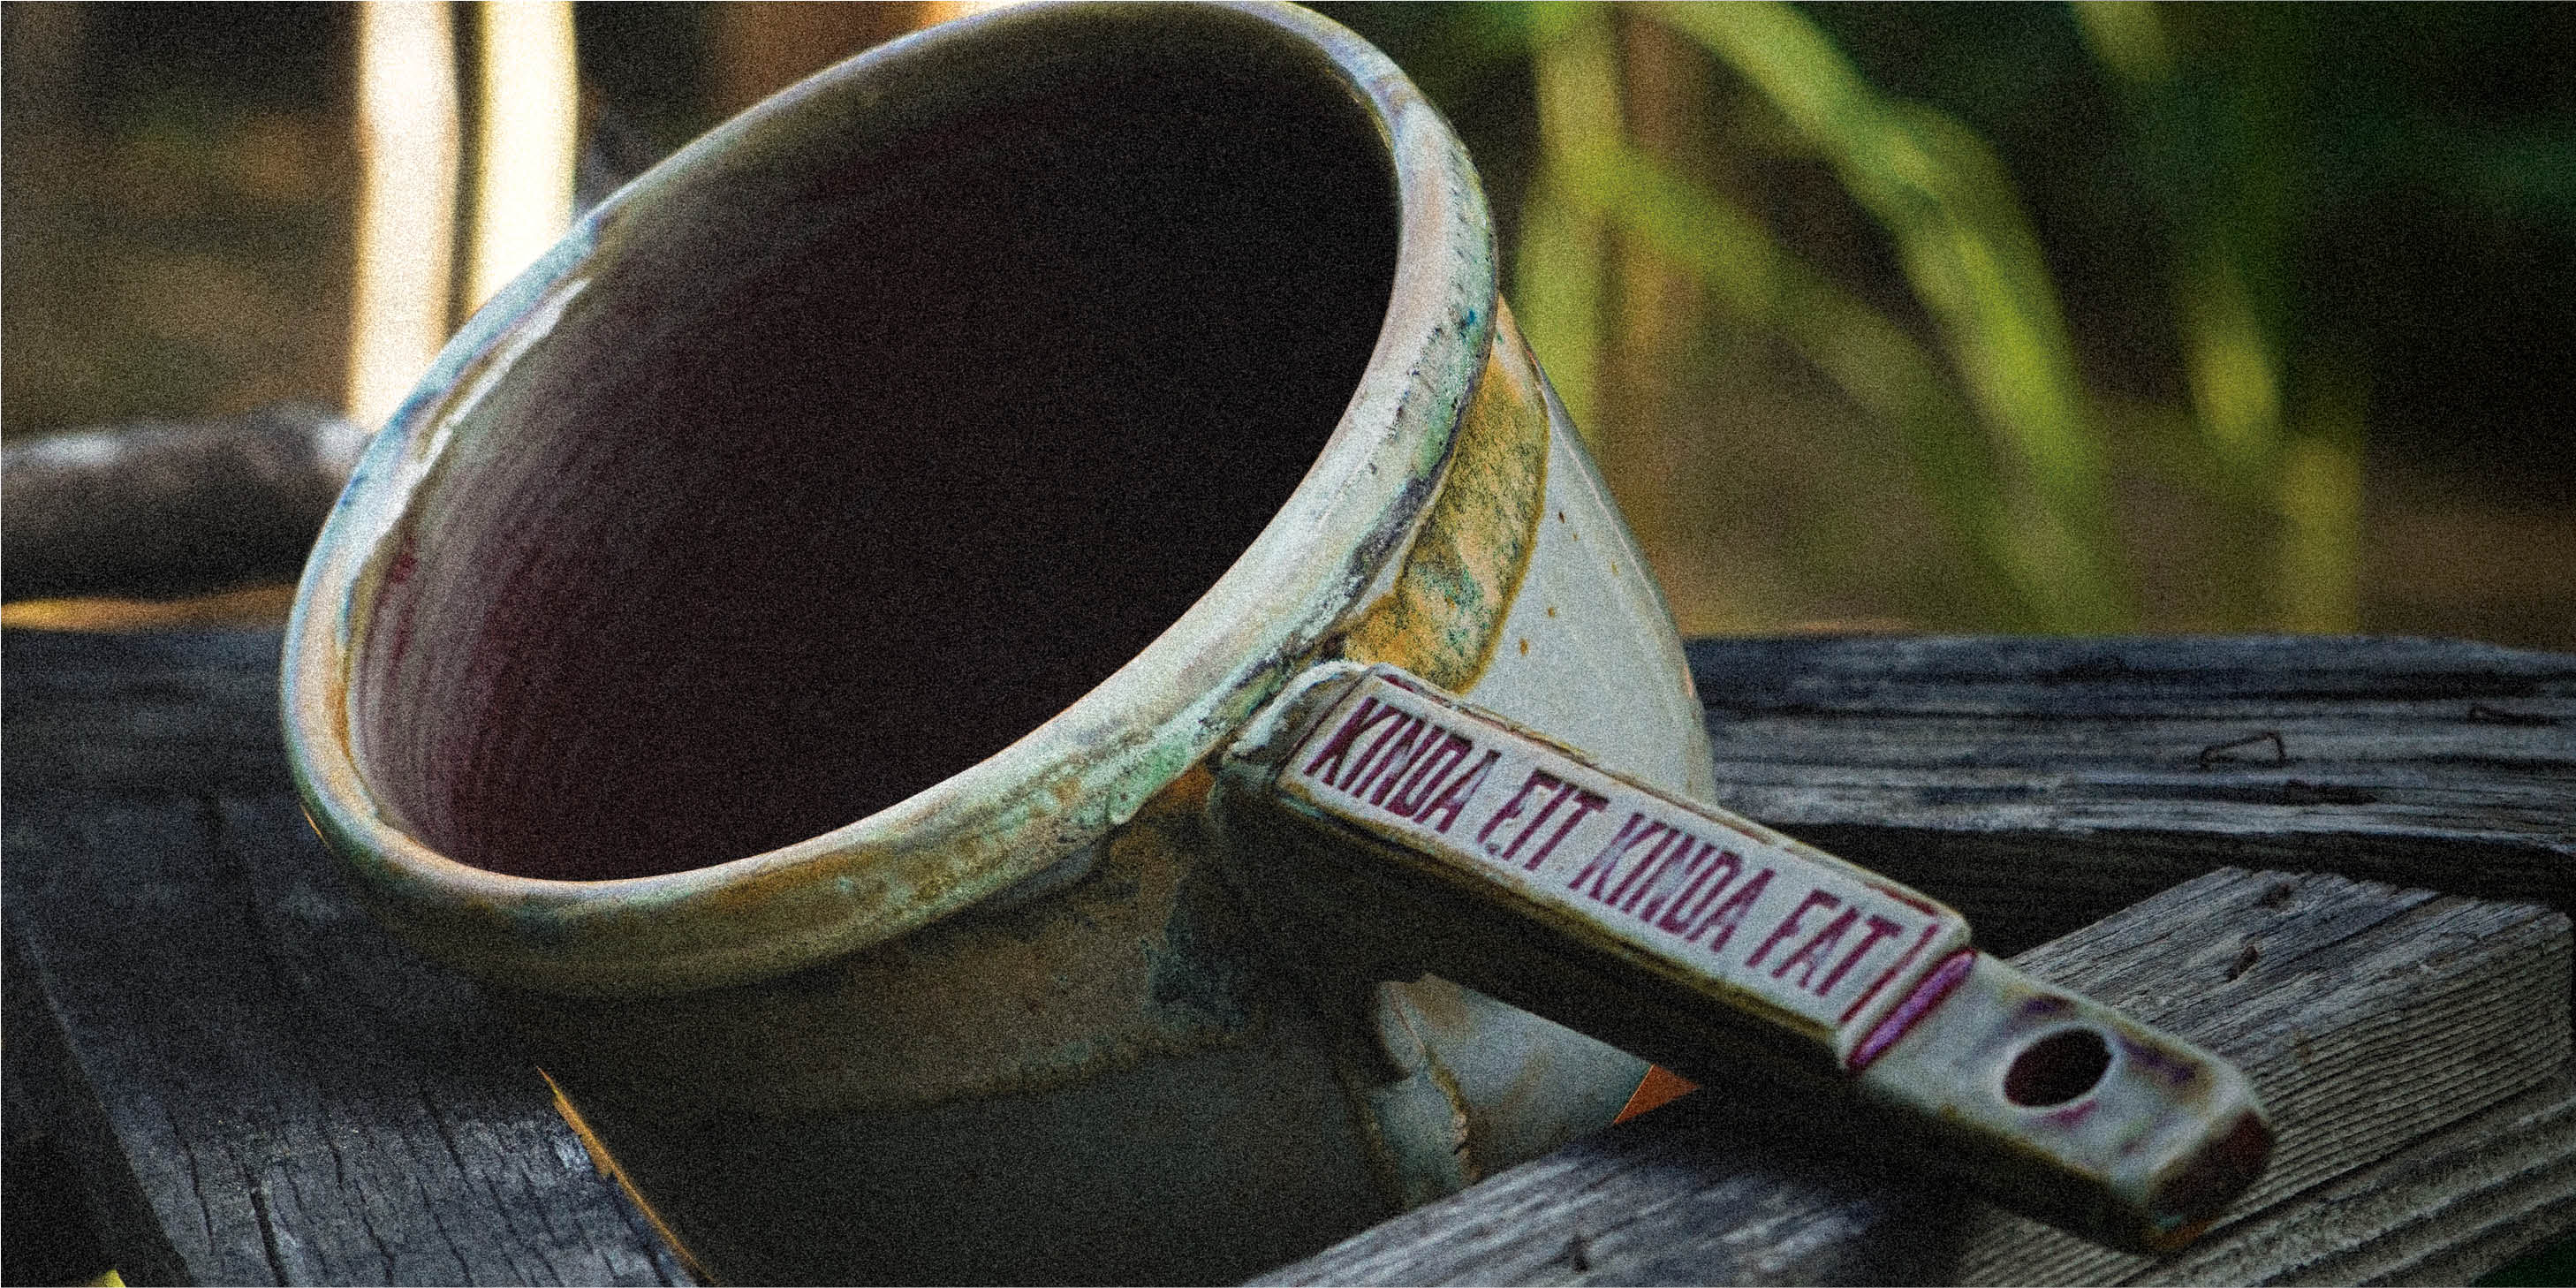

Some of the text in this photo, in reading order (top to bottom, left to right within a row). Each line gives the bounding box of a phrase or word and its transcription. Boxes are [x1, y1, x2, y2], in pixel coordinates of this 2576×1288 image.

[1302, 696, 1502, 834] KINDA
[1568, 812, 1777, 953] KINDA
[1745, 887, 1904, 998] FAT
